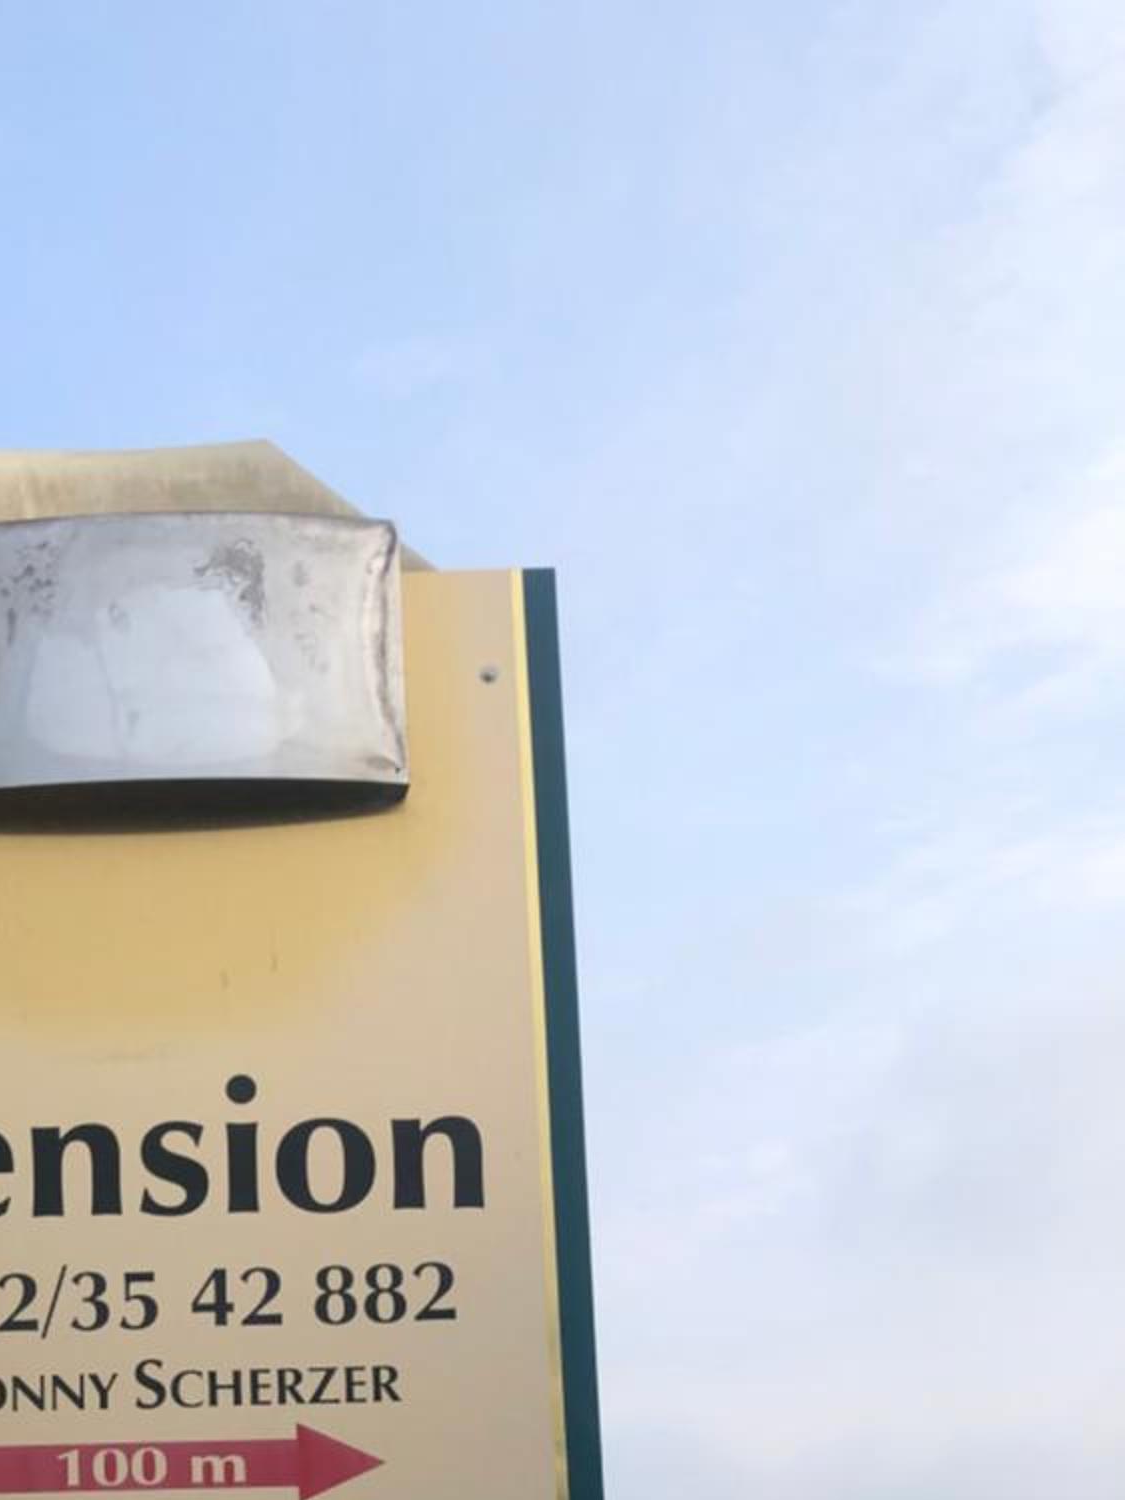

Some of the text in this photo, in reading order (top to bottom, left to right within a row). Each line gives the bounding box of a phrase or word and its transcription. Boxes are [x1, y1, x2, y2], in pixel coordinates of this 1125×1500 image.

[191, 1267, 283, 1327] 42
[314, 1261, 457, 1326] 882
[134, 1359, 402, 1410] SCHERZER
[57, 1448, 247, 1486] 100 m
